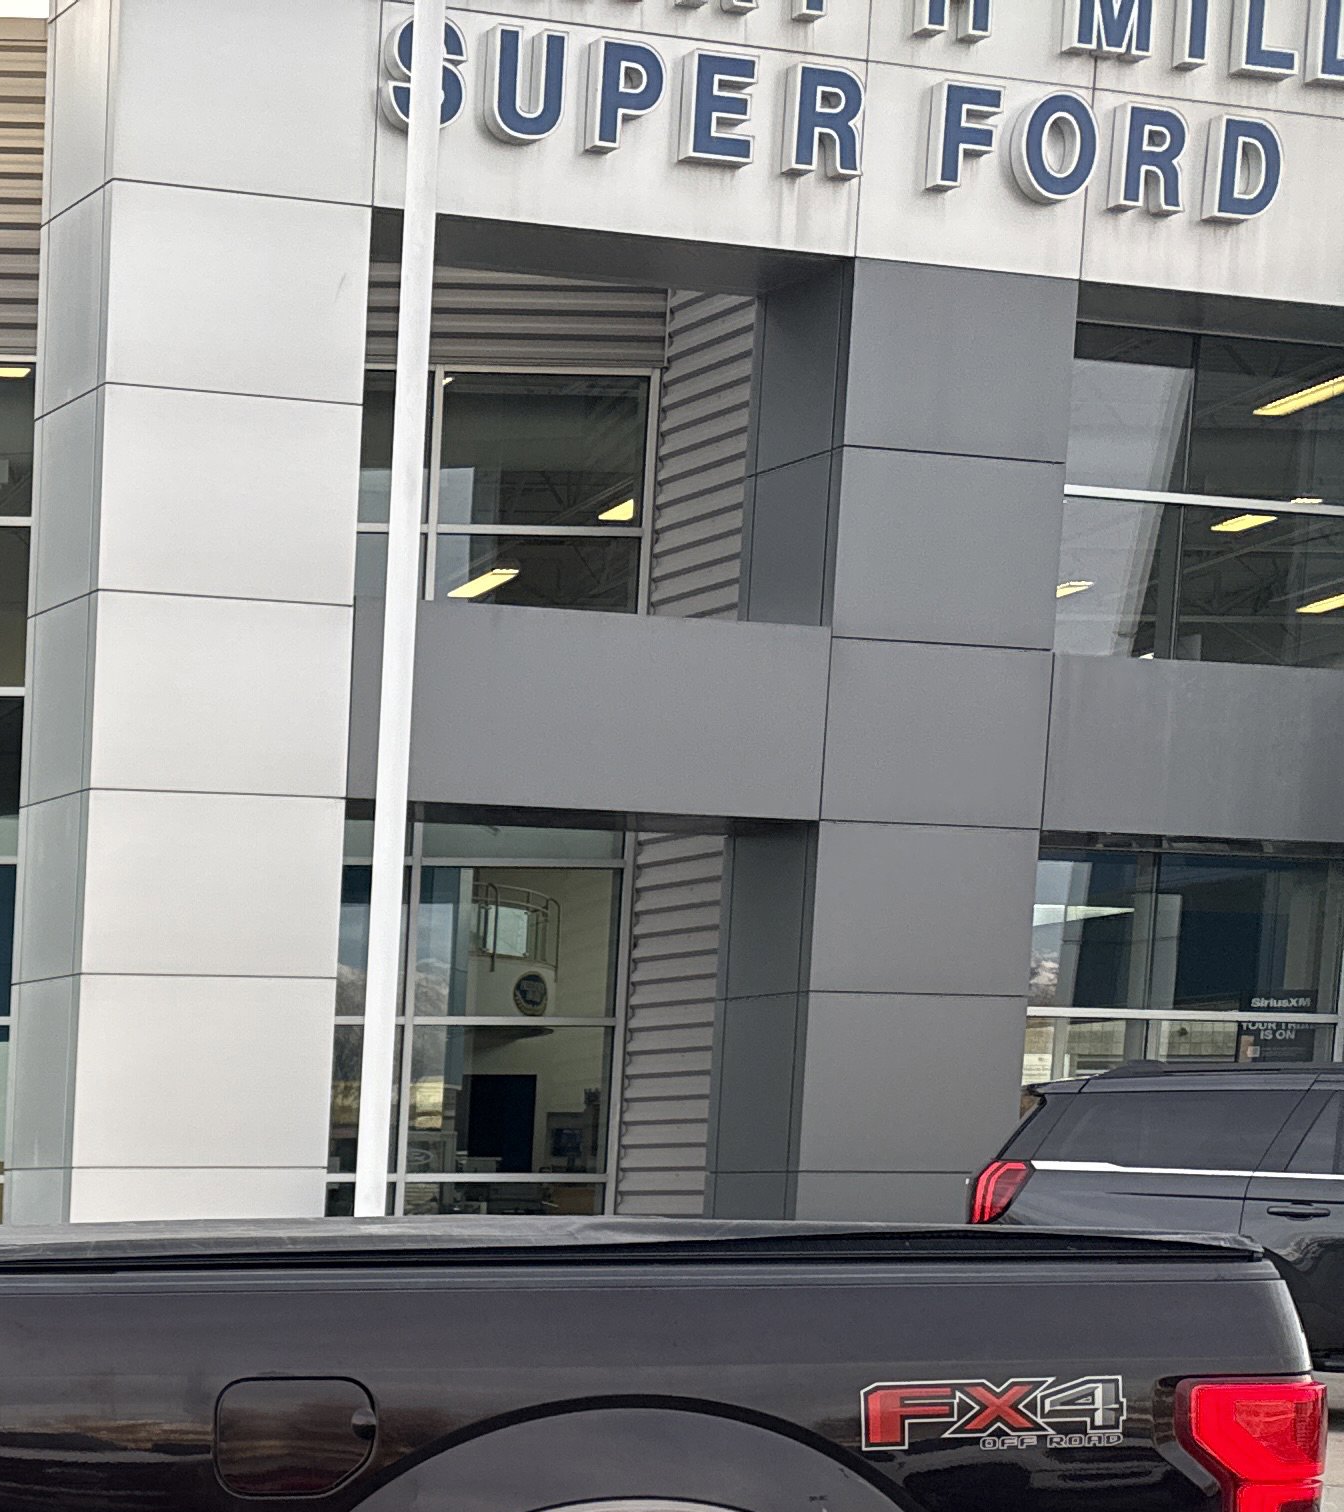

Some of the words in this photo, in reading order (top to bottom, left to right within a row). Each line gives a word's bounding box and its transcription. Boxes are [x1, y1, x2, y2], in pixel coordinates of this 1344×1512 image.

[381, 13, 867, 181] SUPER
[925, 80, 1284, 226] FORD
[1250, 997, 1312, 1008] SiriusXM
[1259, 1030, 1273, 1040] IS
[1275, 1030, 1296, 1040] ON
[860, 1375, 1127, 1451] FX4
[979, 1434, 1038, 1450] OFF
[1046, 1432, 1124, 1449] ROAD
